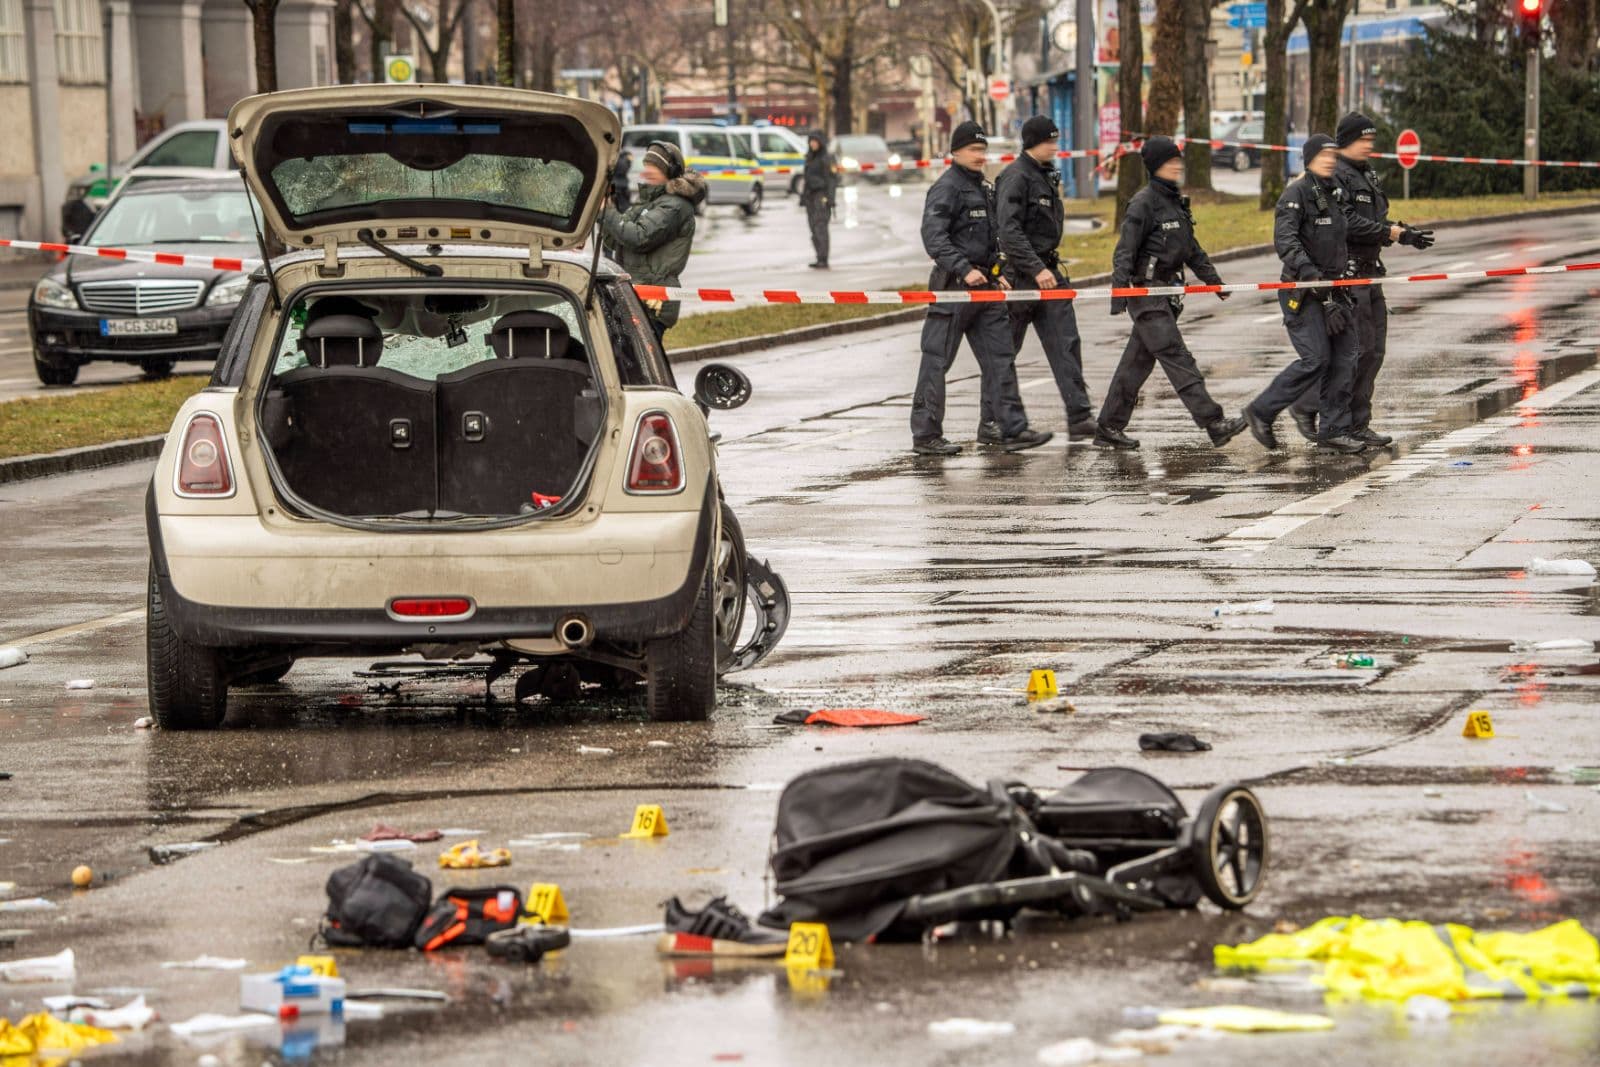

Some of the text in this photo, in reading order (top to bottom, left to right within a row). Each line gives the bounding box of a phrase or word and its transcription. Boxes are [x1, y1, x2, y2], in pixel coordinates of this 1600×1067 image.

[1041, 673, 1050, 689] 1
[1475, 714, 1492, 732] 15
[638, 810, 654, 830] 16
[792, 931, 818, 955] 20
